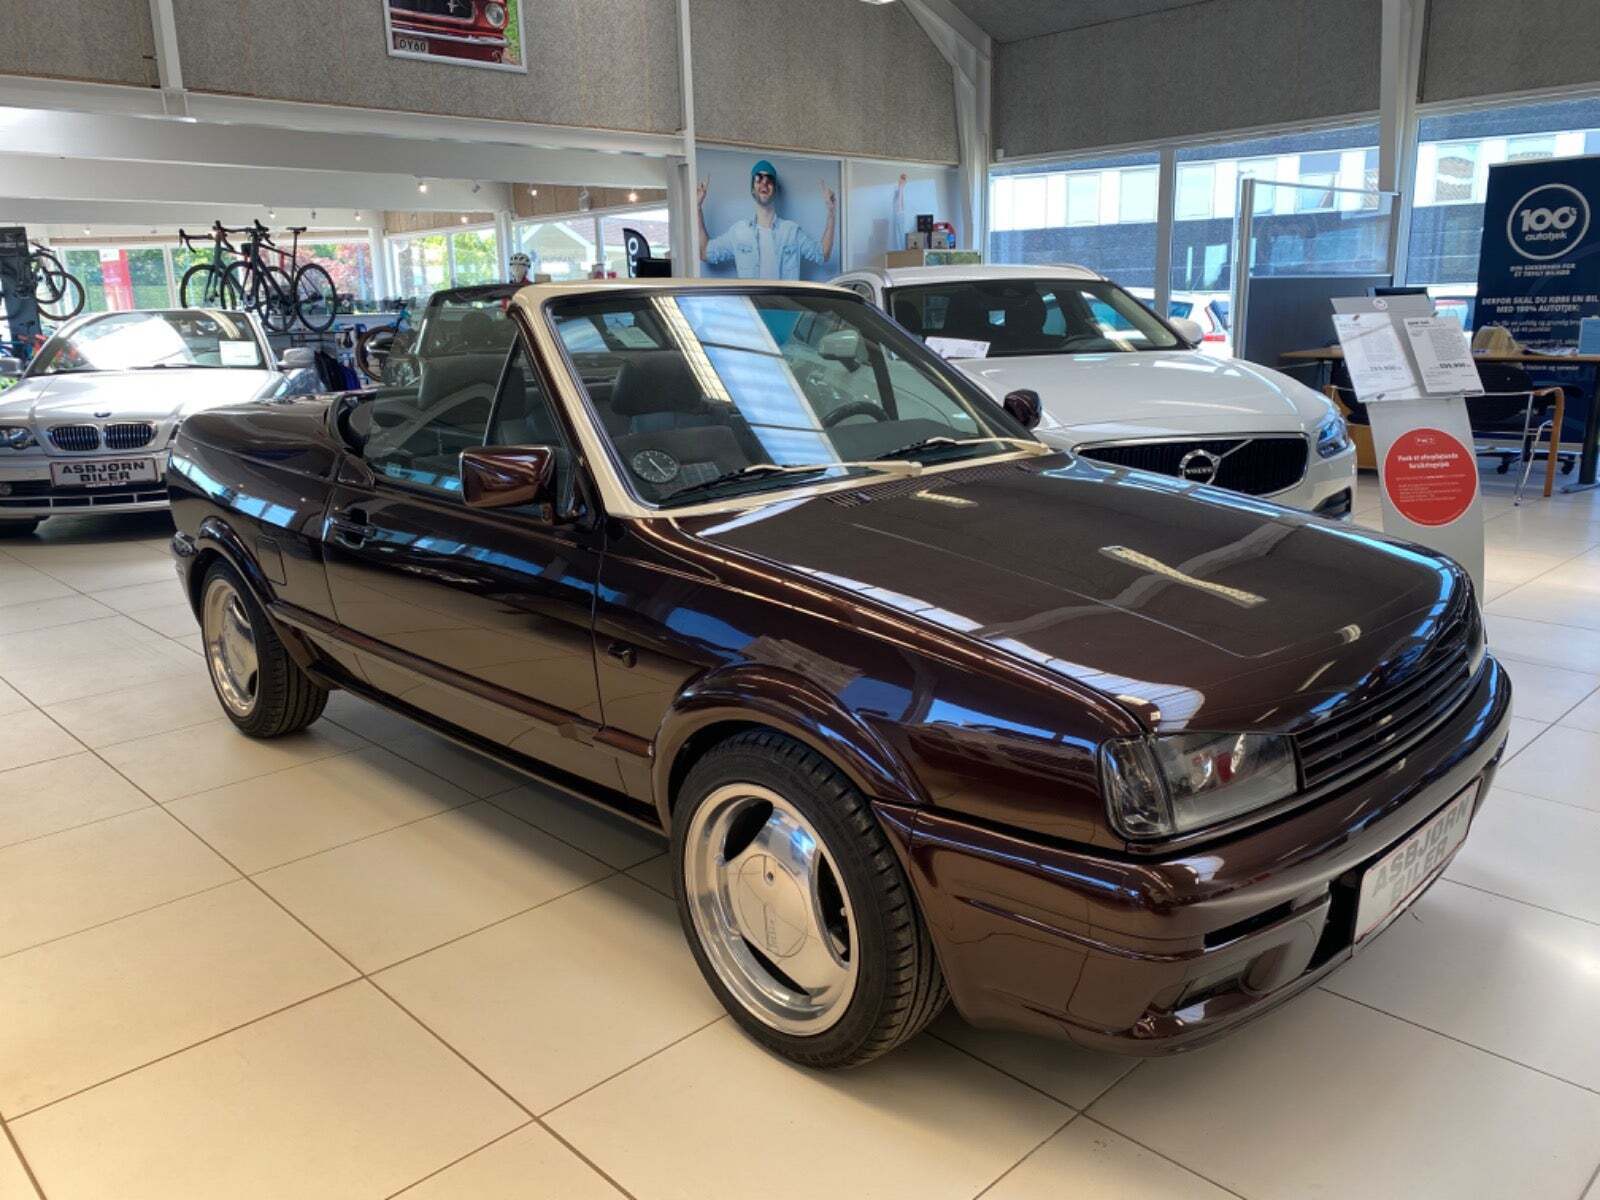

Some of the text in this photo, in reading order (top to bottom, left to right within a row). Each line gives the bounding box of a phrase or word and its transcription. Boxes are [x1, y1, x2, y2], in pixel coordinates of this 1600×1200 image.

[1481, 297, 1511, 306] DERFOR
[1512, 296, 1533, 305] SKAL
[1534, 296, 1546, 304] DU
[1572, 295, 1583, 303] EN
[1585, 294, 1599, 303] BIL
[1496, 306, 1514, 314] MED
[62, 462, 145, 474] ASBJØRN
[80, 471, 131, 482] BILER
[1372, 795, 1470, 898] ASBJØRN
[1391, 836, 1448, 902] BILER
